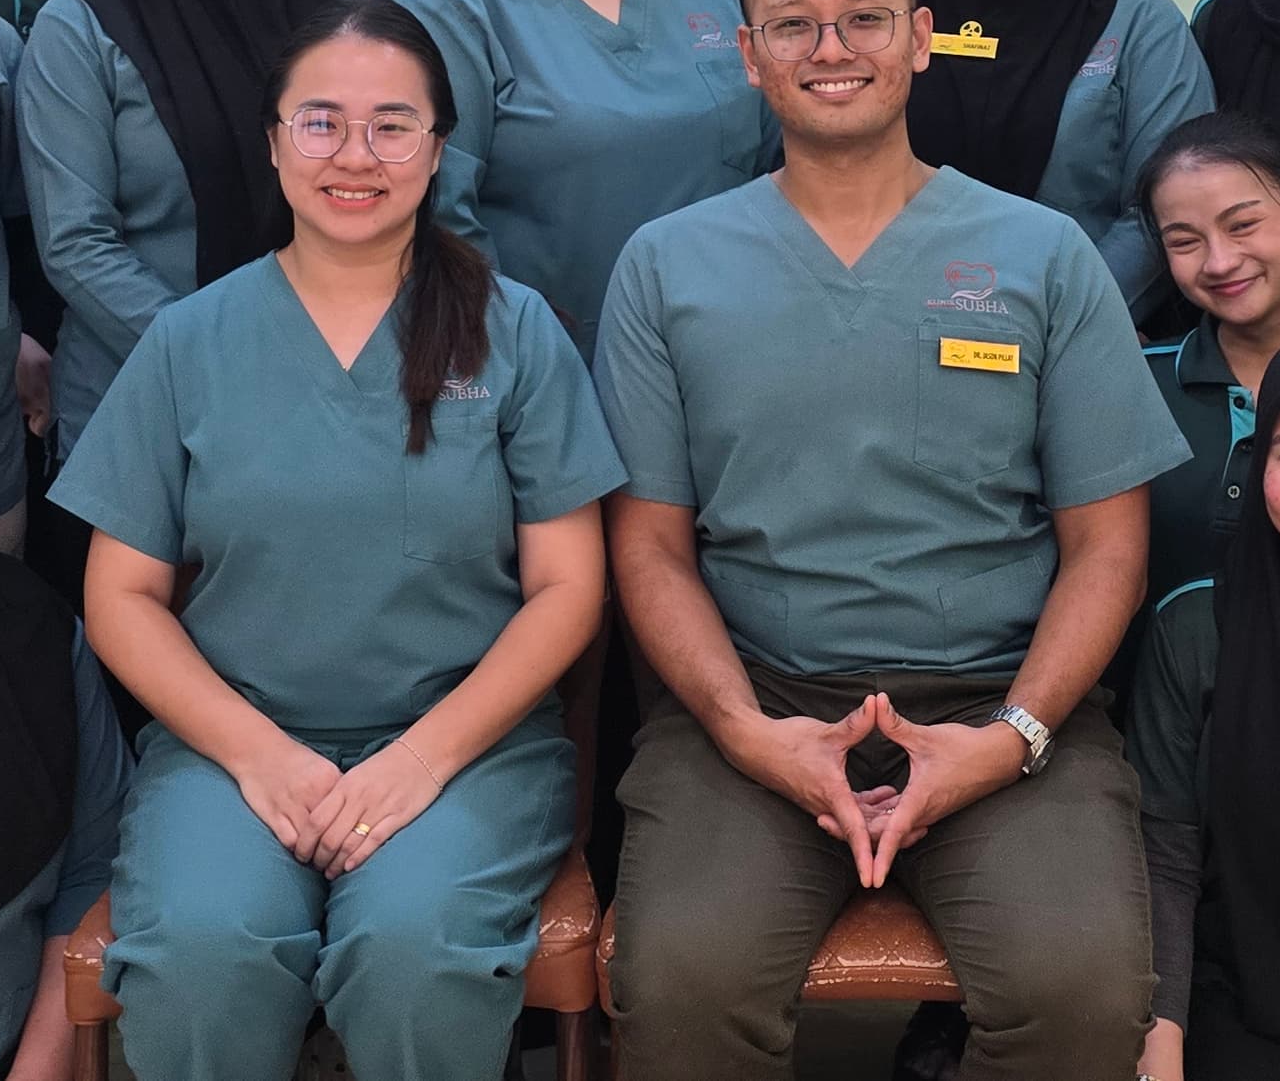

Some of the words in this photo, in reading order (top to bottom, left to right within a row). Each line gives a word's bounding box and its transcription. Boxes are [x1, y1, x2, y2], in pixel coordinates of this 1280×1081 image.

[1080, 63, 1117, 78] SUBH
[955, 298, 1009, 314] SUBHA
[438, 385, 491, 401] SUBHA
